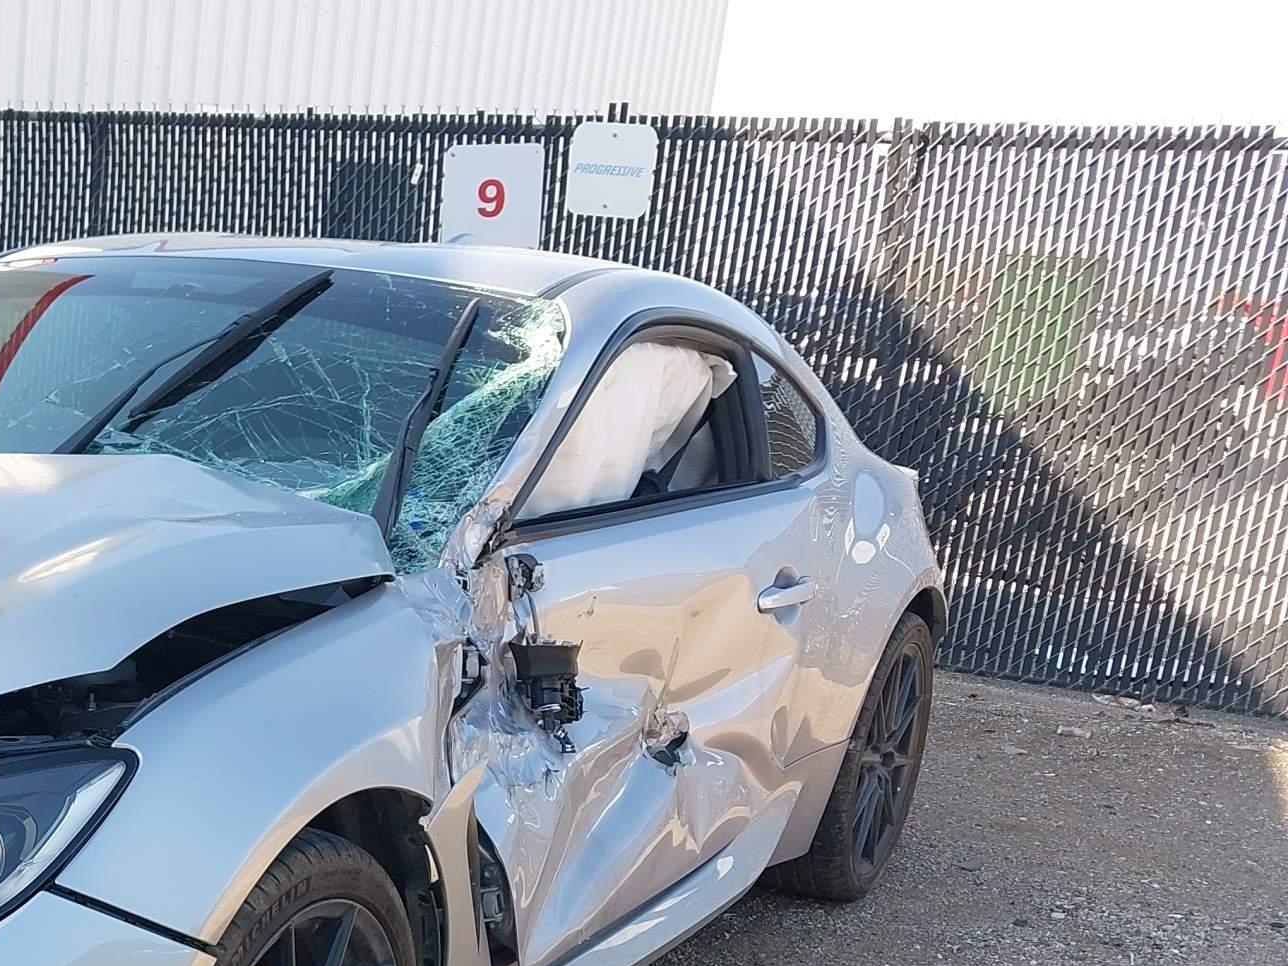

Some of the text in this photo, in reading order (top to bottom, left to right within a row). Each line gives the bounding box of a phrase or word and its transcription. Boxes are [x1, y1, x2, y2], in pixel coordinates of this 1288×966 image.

[574, 162, 647, 178] PROGRESSIVE
[477, 178, 505, 218] 9
[230, 874, 313, 963] MICHELIN
